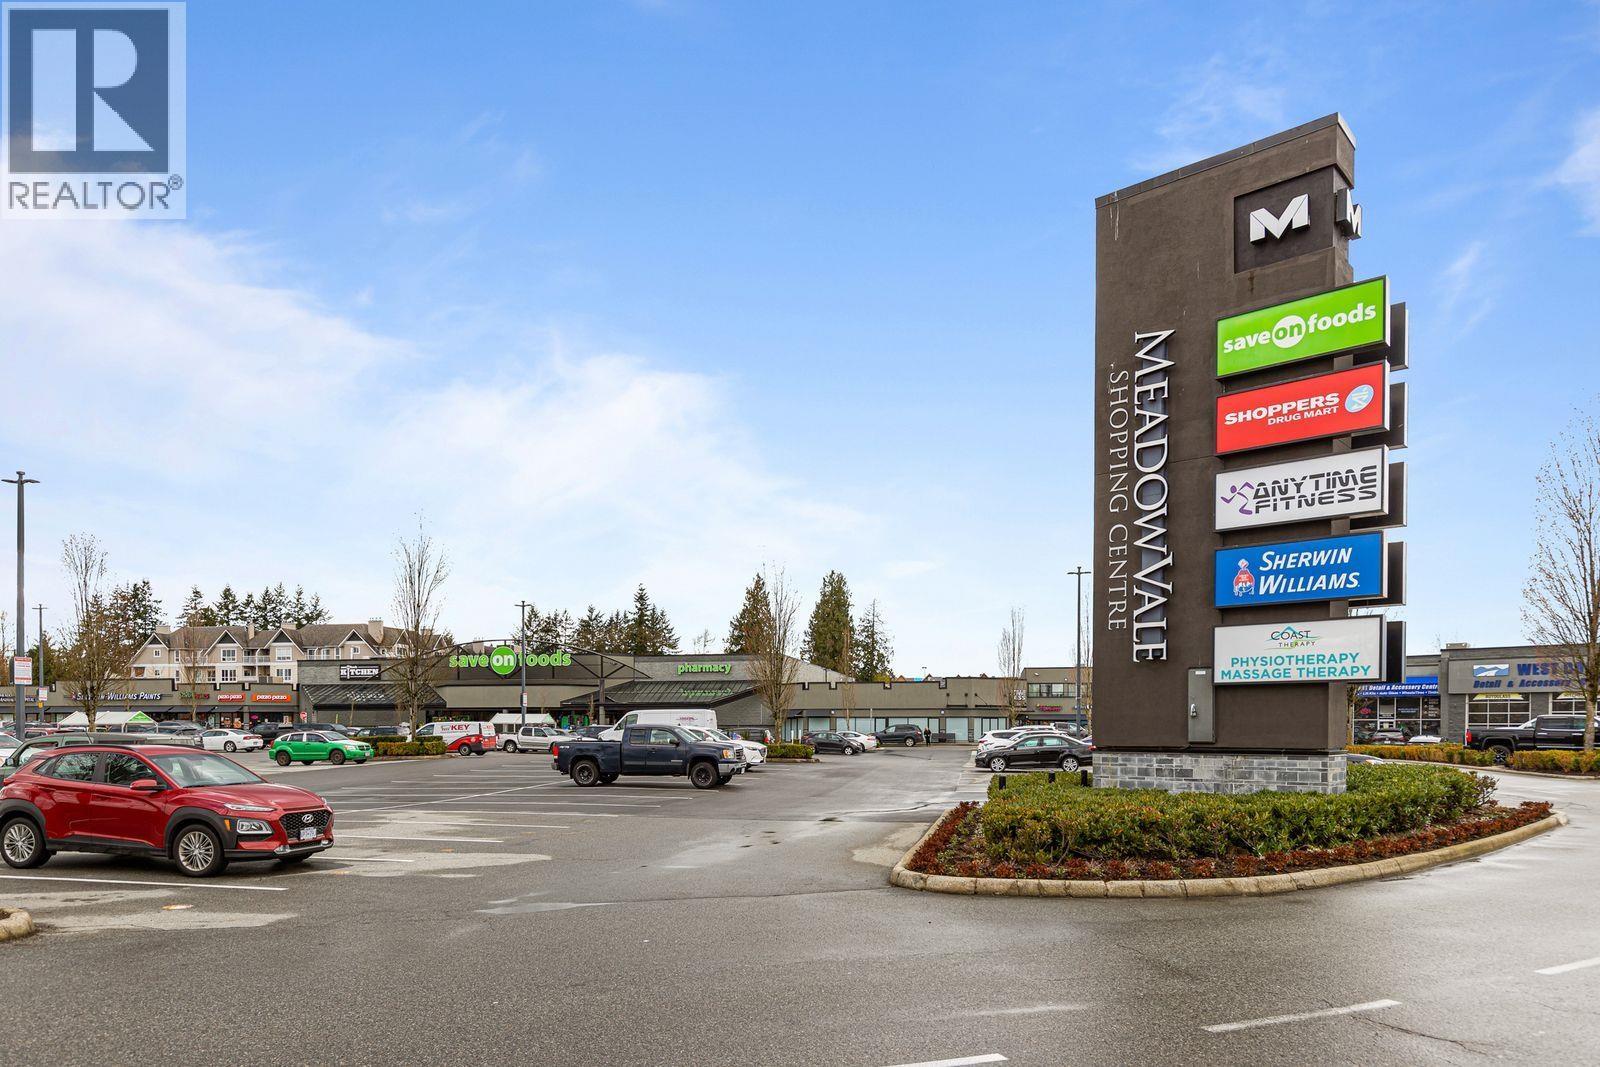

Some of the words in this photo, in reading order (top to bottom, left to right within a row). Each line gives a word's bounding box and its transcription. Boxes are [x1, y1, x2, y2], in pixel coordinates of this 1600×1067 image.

[1250, 193, 1310, 243] M
[1224, 392, 1340, 425] SHOPPERS
[1267, 412, 1302, 426] DRUG
[1303, 405, 1340, 421] MART
[1109, 370, 1129, 513] SHOPPING
[1252, 464, 1378, 499] ANYTIME
[1132, 329, 1176, 663] MEADOWVALE
[1254, 484, 1378, 515] FITNESS
[1108, 524, 1129, 630] CENTRE
[1270, 629, 1312, 642] COAST
[1278, 640, 1317, 649] THERAPY
[677, 662, 732, 675] pharmacy
[1220, 667, 1292, 681] MASSAGE
[1296, 664, 1372, 679] THERAPY
[1230, 652, 1360, 668] PHYSIOTHERAPY
[1473, 679, 1502, 689] Detail
[1507, 680, 1514, 688] &
